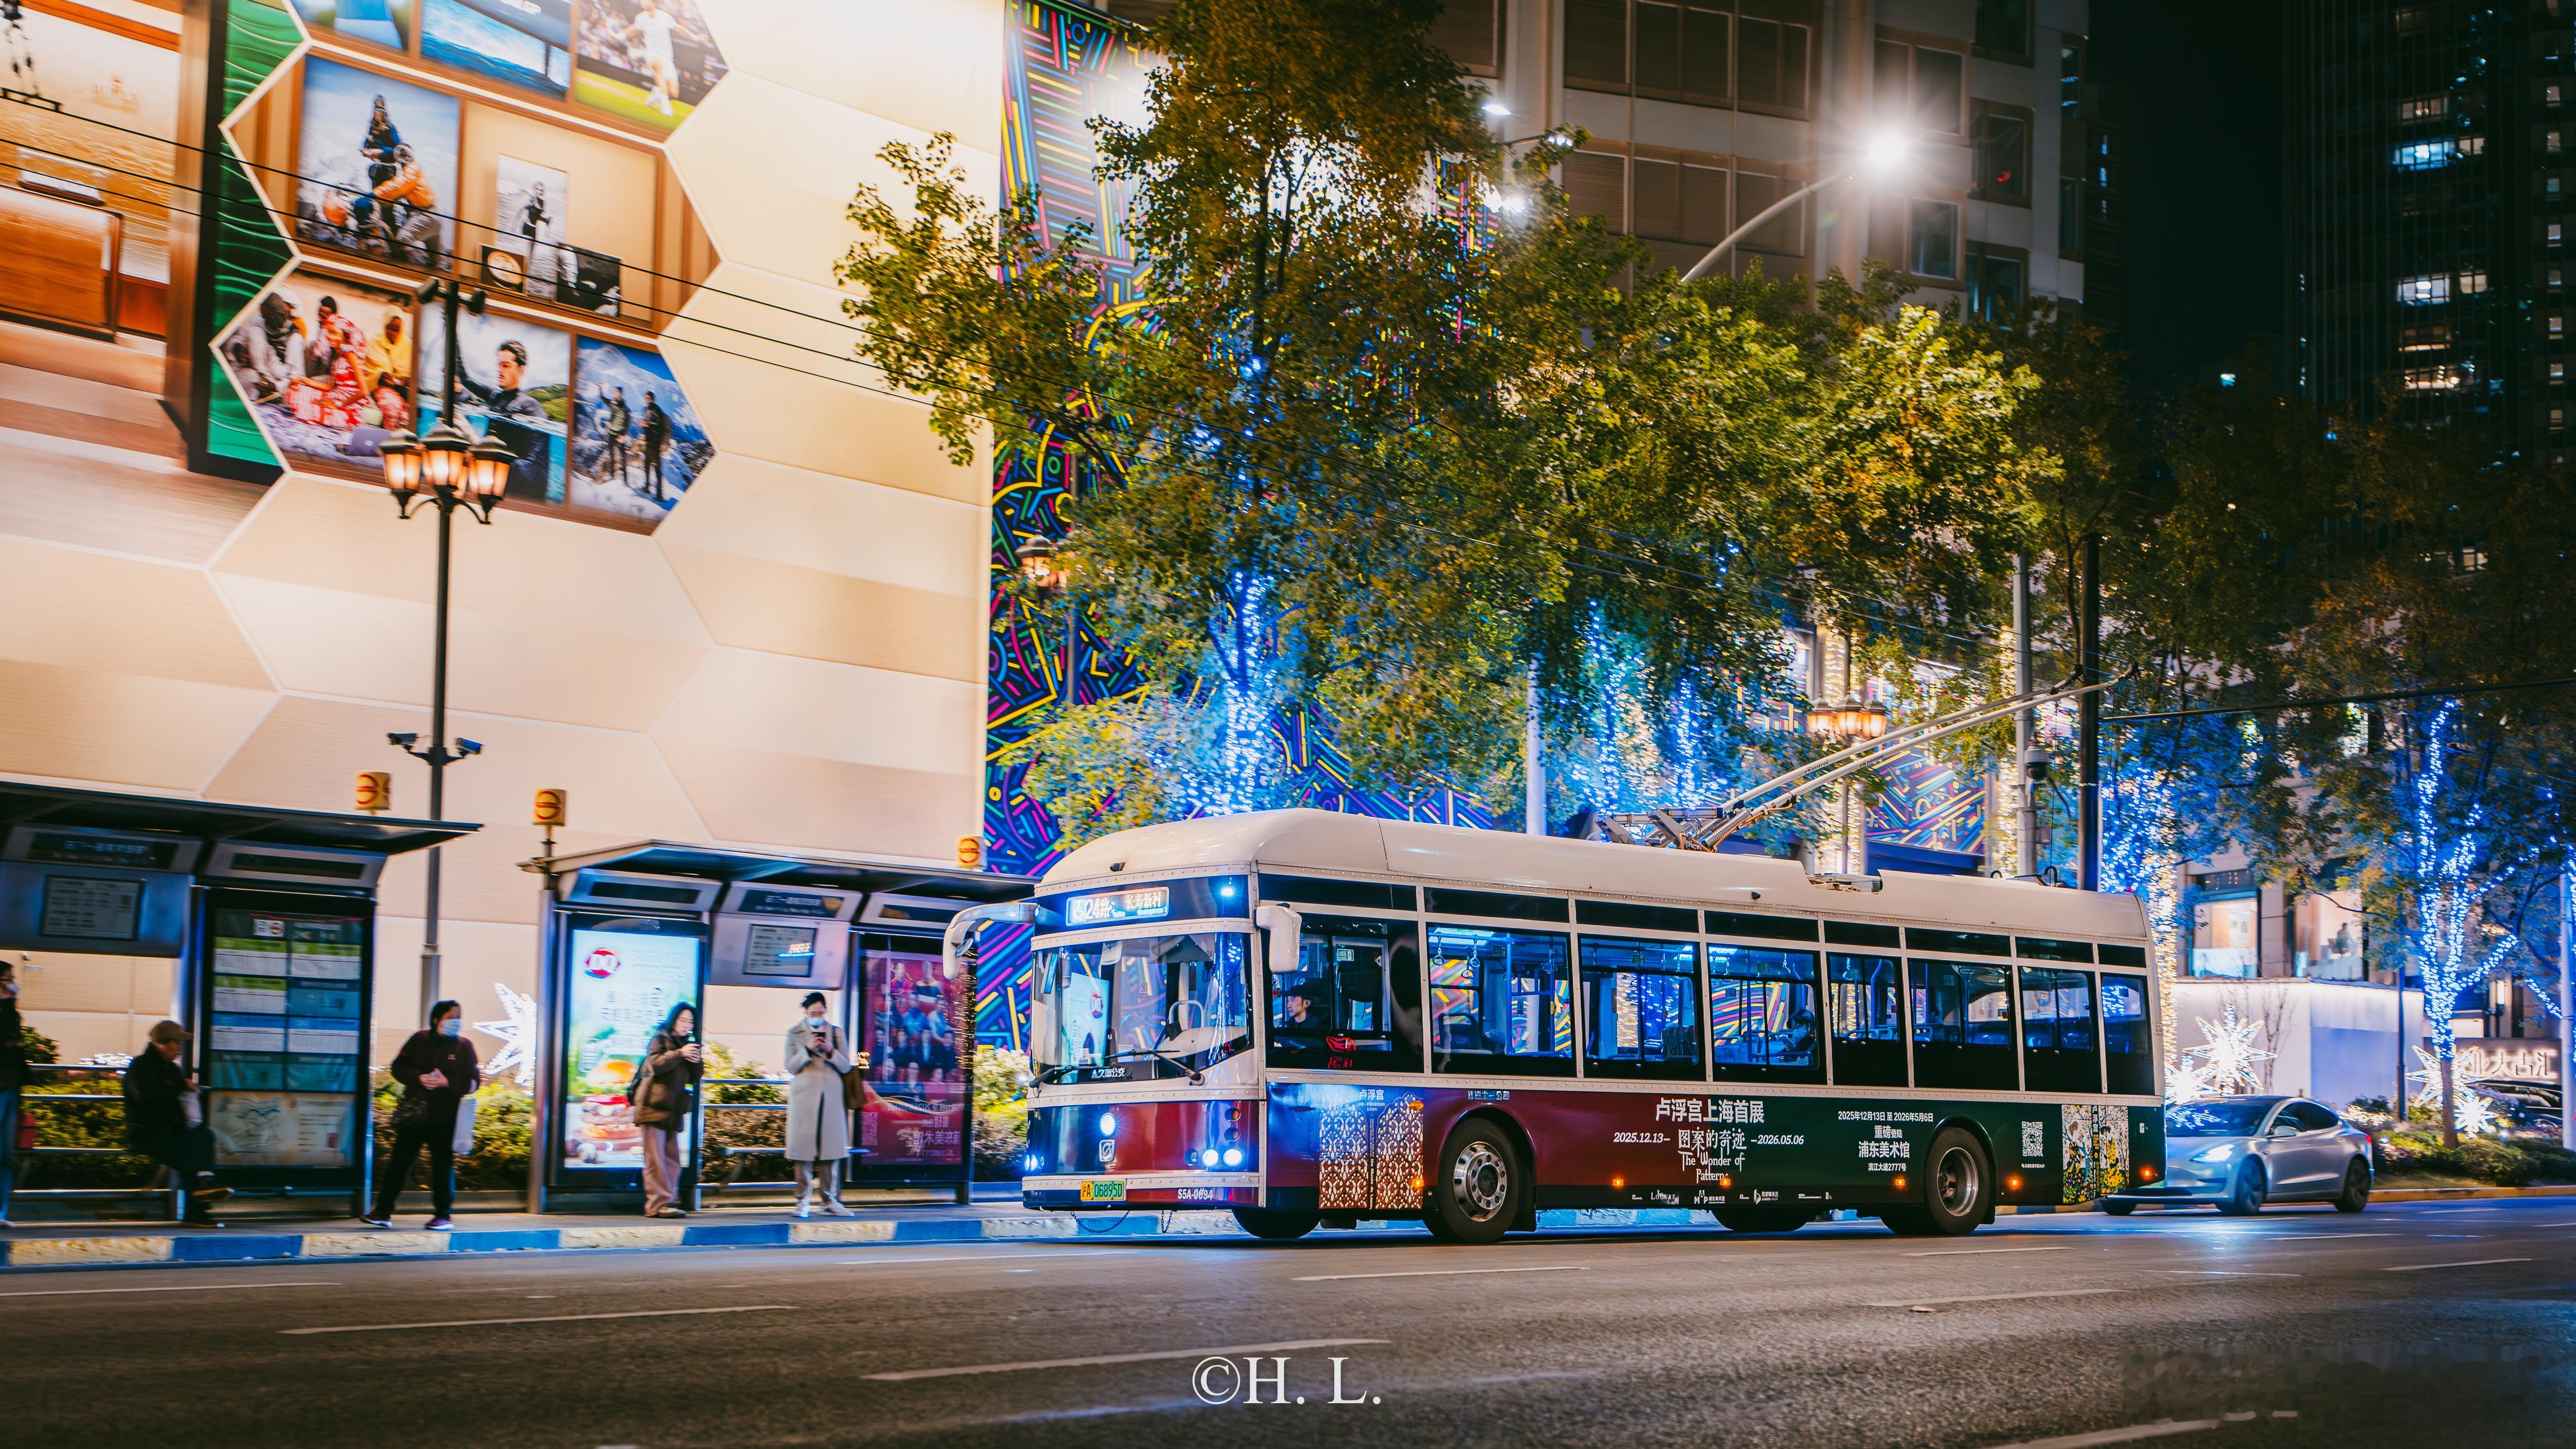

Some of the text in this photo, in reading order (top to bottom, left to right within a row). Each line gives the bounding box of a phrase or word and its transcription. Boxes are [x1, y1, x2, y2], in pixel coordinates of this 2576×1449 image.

[1126, 891, 1162, 909] 长寿新村
[1360, 1089, 1384, 1100] 卢浮宫
[1656, 1097, 1764, 1123] 卢浮宫上海首展
[1838, 1111, 1933, 1122] 2025年12月13日 至 2026年5月6日
[1875, 1125, 1902, 1138] 重磅登陆
[1678, 1127, 1747, 1154] 图案的奇迹
[1859, 1141, 1910, 1158] 浦东美术馆
[1677, 1147, 1745, 1172] The Wonder of
[1868, 1163, 1907, 1171] 滨江大道2777号
